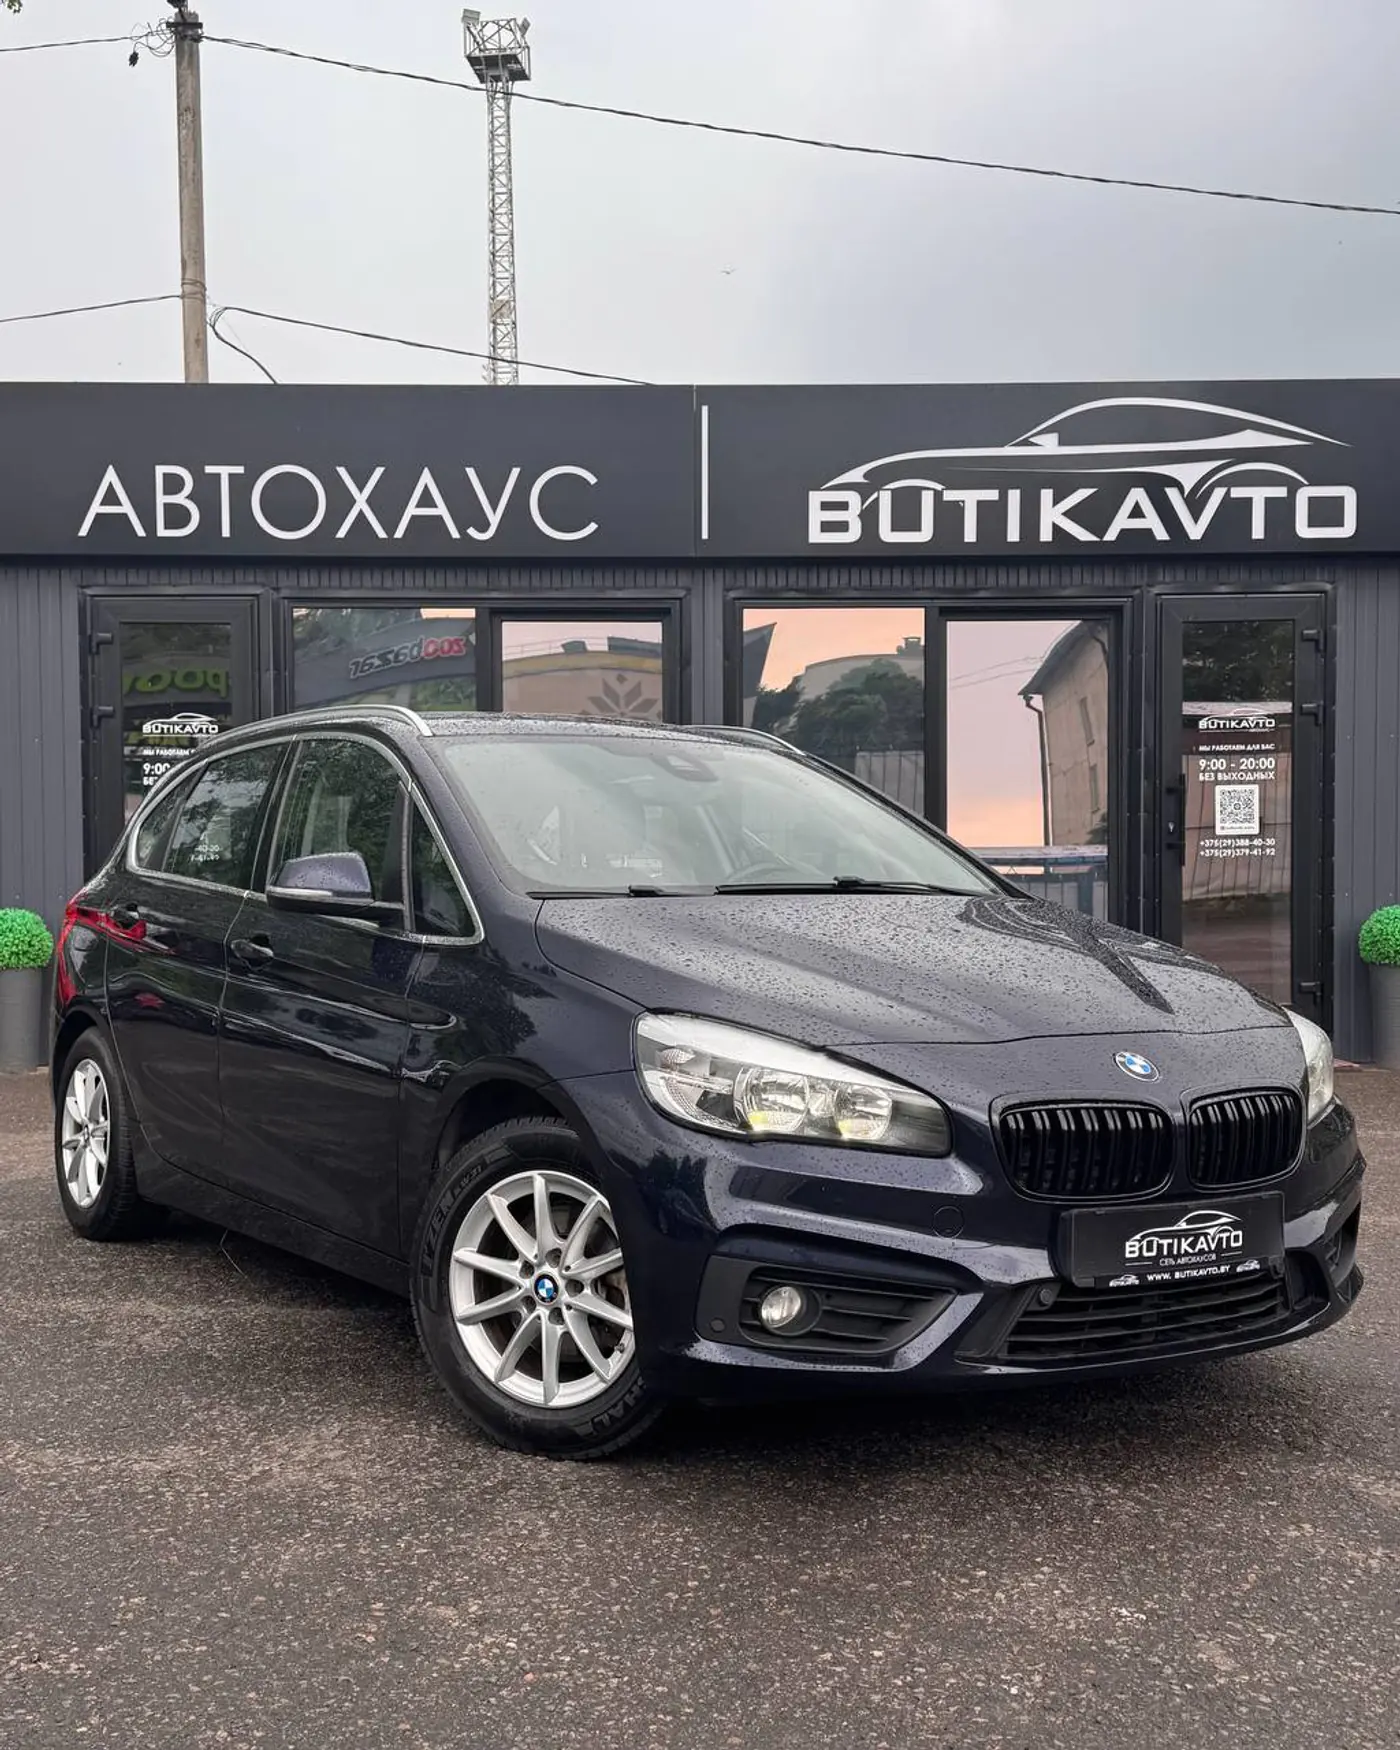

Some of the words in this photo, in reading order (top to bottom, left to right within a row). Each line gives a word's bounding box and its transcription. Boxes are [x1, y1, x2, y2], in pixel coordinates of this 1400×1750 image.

[77, 463, 599, 541] АВТОХАУС
[807, 484, 1358, 544] BUTIKAVTO
[142, 724, 219, 734] BUTIKAVTO
[1198, 718, 1276, 729] BUTIKAVTO
[1261, 743, 1276, 751] ВАС
[1199, 758, 1227, 771] 9:00
[1239, 757, 1276, 770] 20:00
[1198, 772, 1216, 781] БЕЗ
[1217, 771, 1276, 781] ВЫХОДНЫХ
[1124, 1230, 1244, 1259] BUTIKAVTO
[1174, 1264, 1231, 1280] BUTIKAVTO.BY
